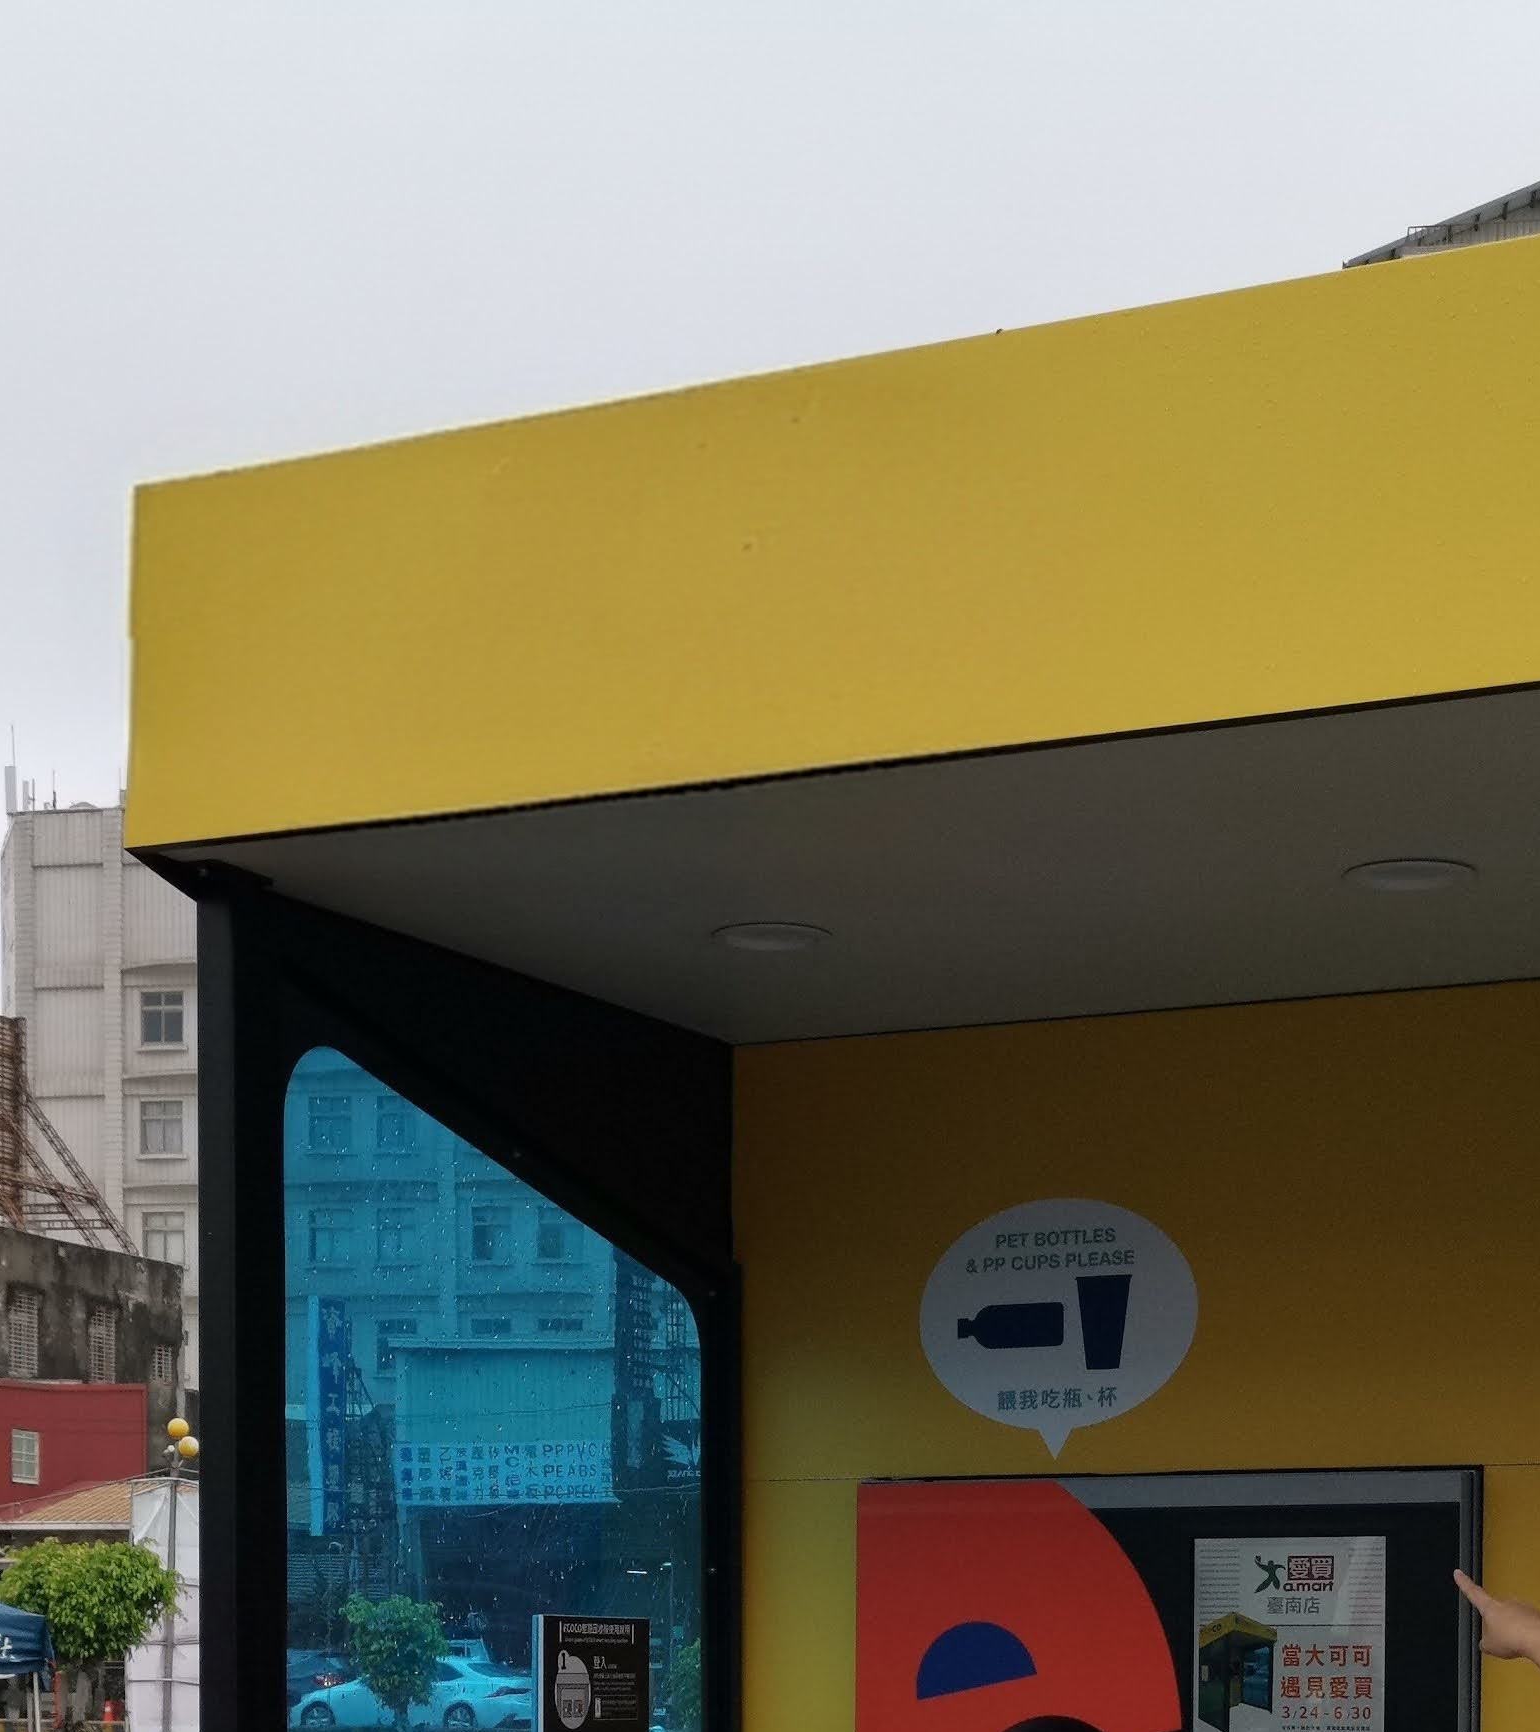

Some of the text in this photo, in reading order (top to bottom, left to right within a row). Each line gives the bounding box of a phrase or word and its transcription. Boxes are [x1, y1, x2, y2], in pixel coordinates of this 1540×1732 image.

[995, 1227, 1117, 1249] PET BOTTLES
[965, 1249, 1135, 1273] & PP CUPS PLEASE
[997, 1386, 1118, 1410] 餵我吃瓶、杯
[1289, 1557, 1333, 1580] 愛買
[1267, 1596, 1320, 1615] 臺南店
[1281, 1643, 1373, 1668] 當大可可
[1280, 1675, 1373, 1700] 遇見愛買
